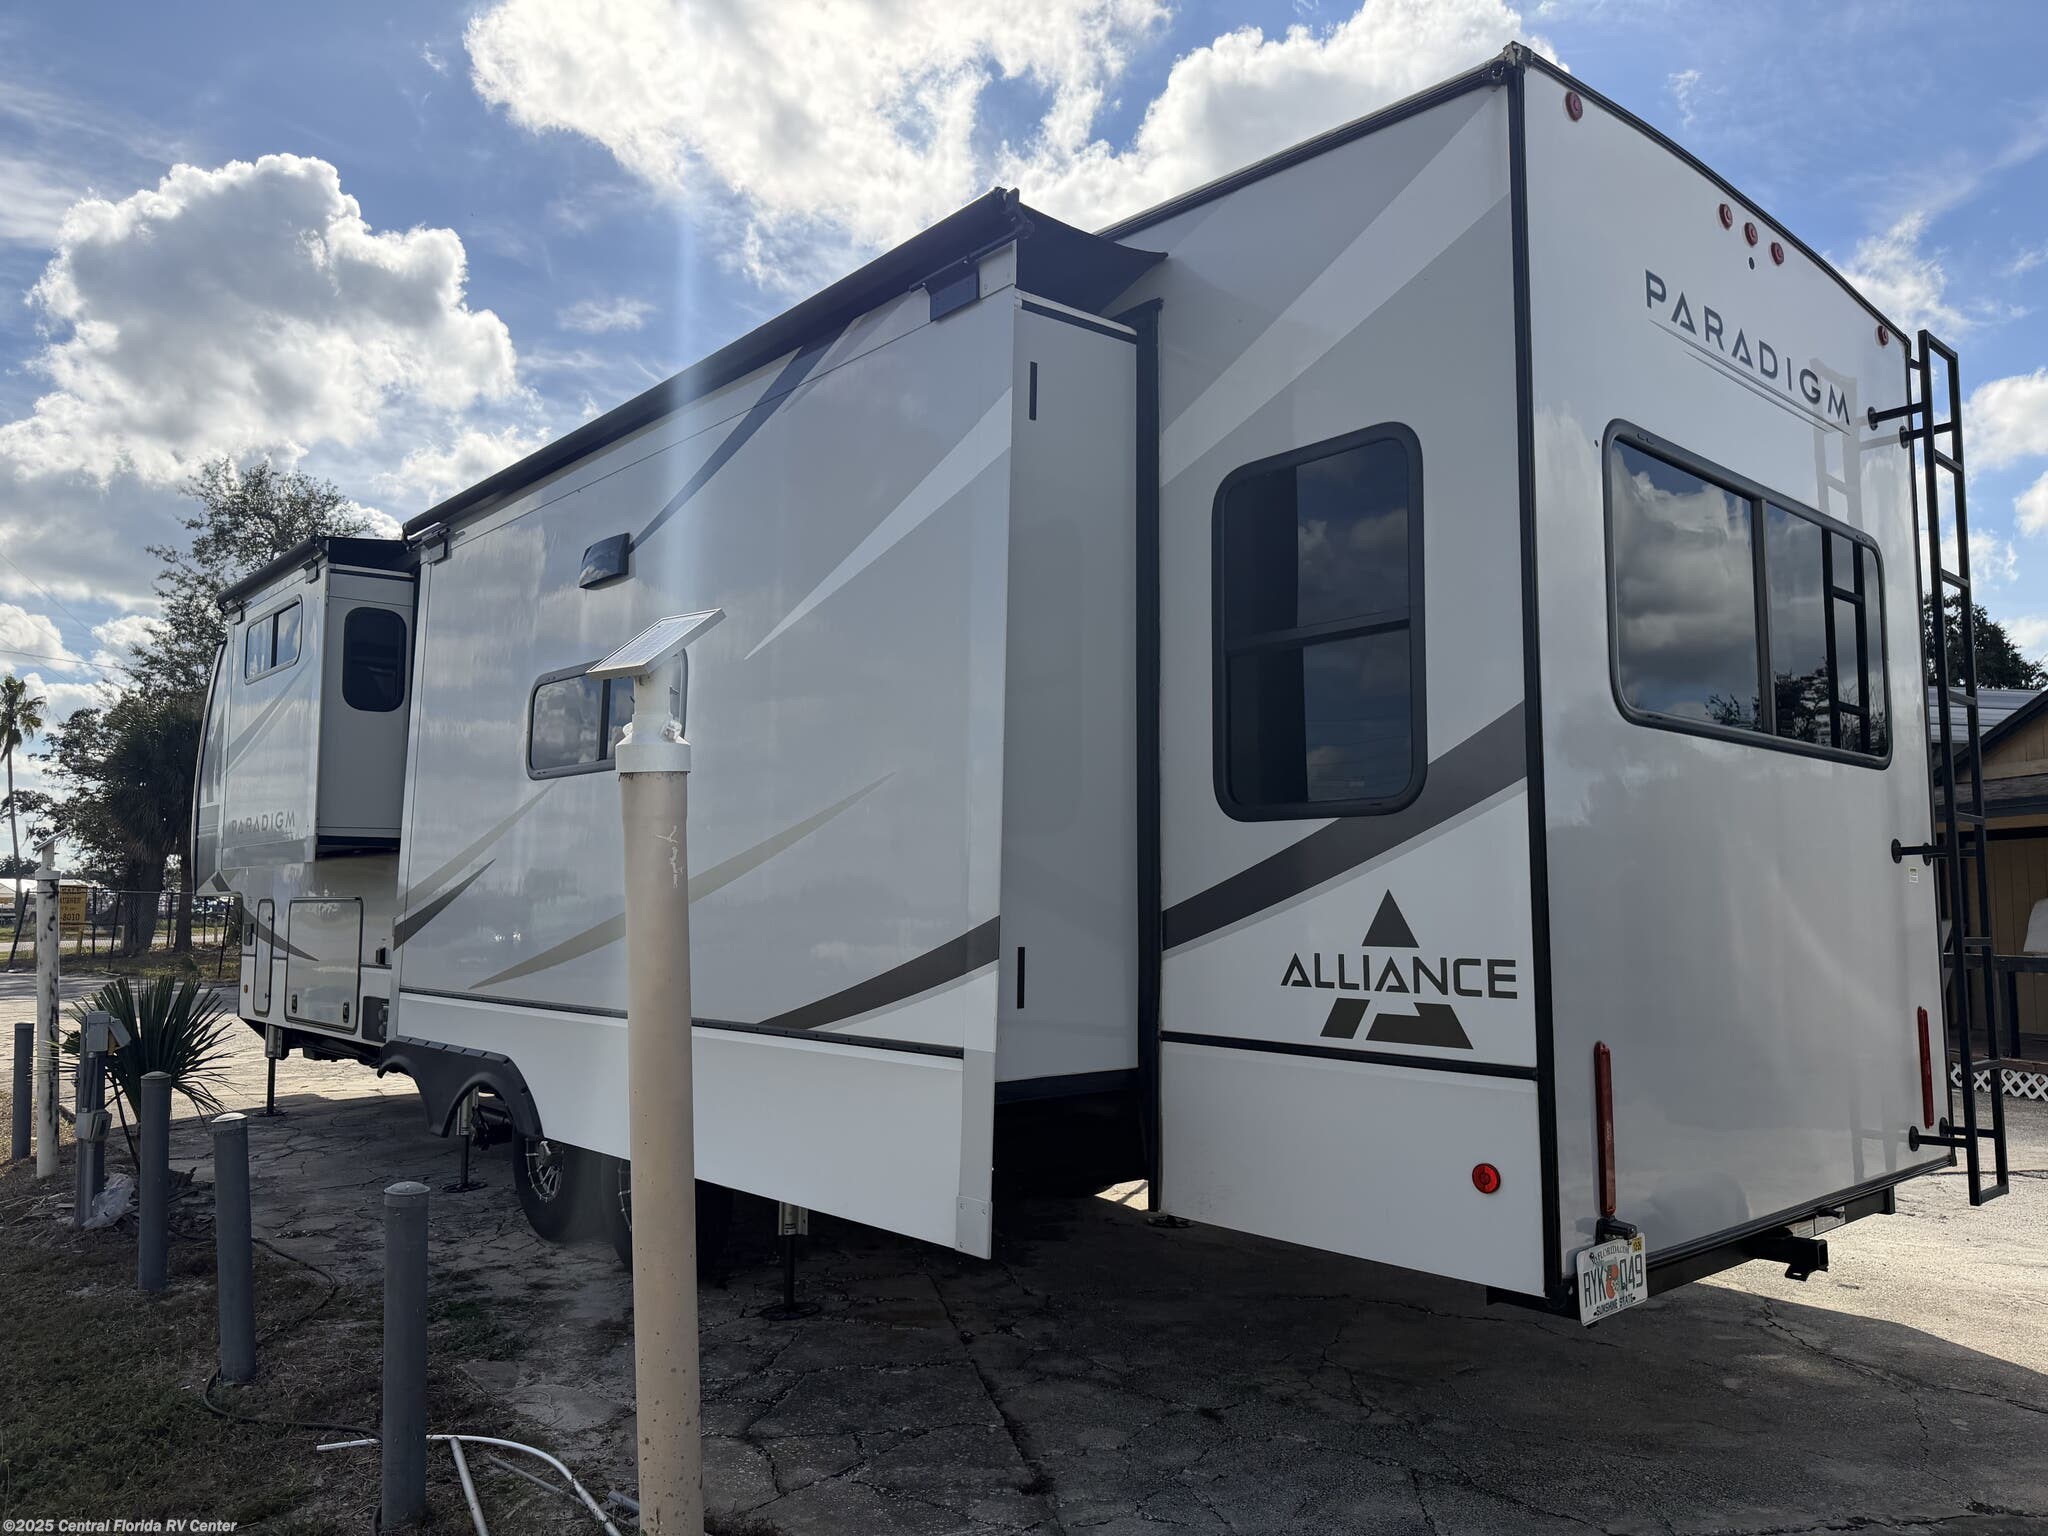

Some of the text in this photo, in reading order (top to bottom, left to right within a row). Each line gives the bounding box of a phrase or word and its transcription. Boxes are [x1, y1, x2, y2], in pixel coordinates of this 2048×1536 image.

[1645, 269, 1850, 426] PARADIGM
[231, 810, 295, 835] PARADIGM
[1280, 952, 1518, 1000] ALLIANCE
